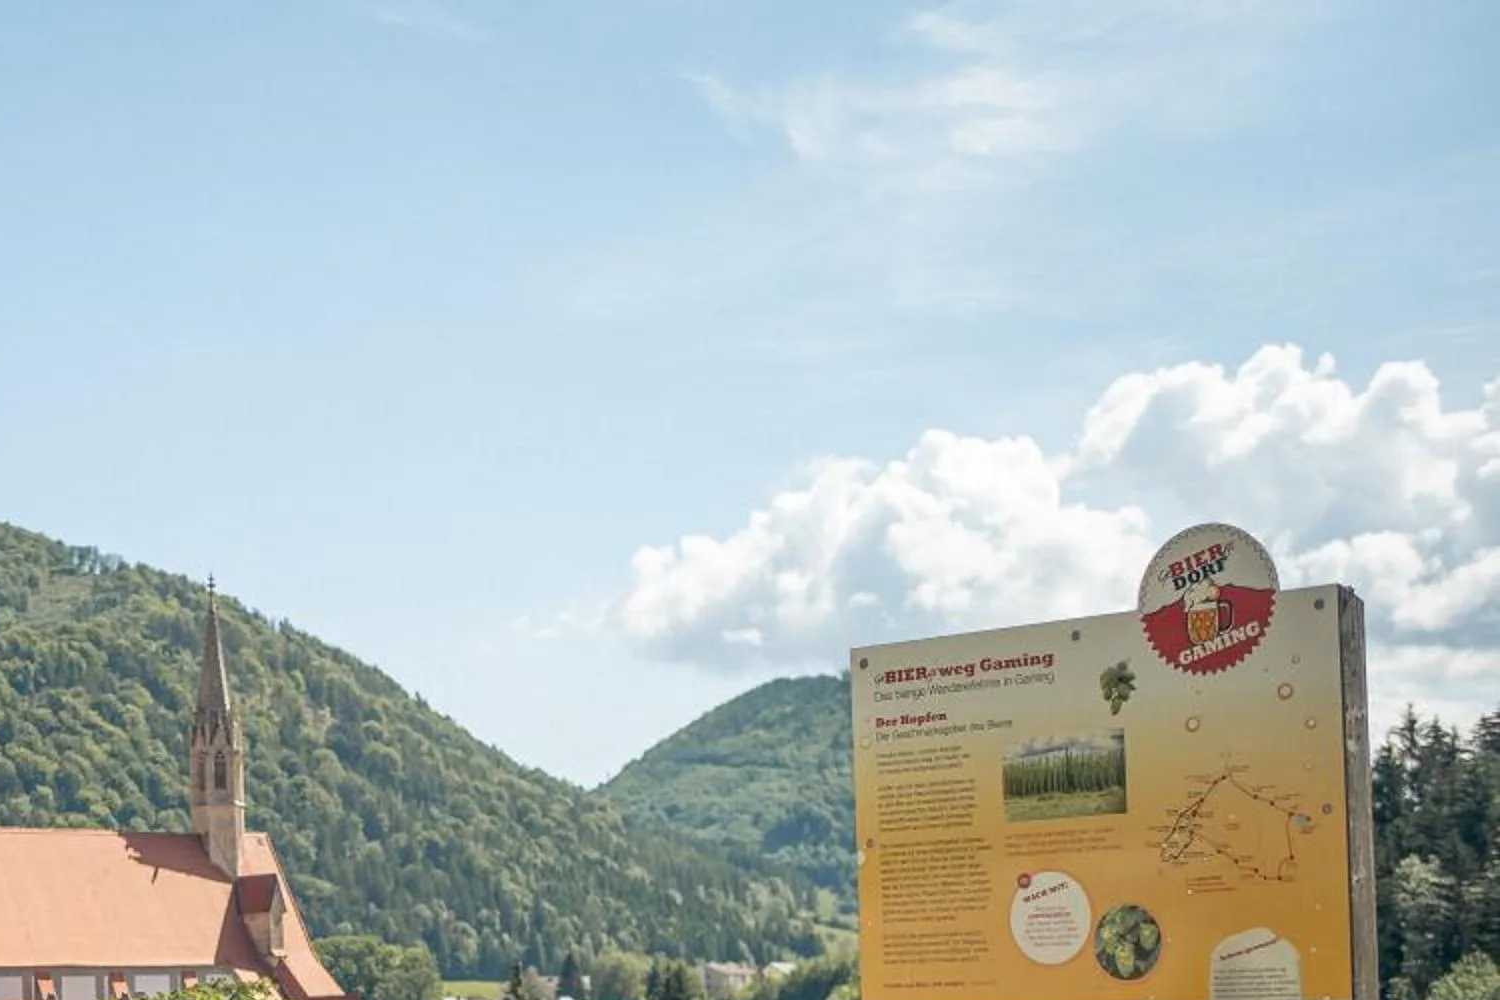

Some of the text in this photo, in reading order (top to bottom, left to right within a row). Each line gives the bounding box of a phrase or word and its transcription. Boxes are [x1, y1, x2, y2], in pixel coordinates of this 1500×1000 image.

[1171, 556, 1227, 591] DORF
[1179, 621, 1260, 665] GAMING
[979, 652, 1055, 672] Gaming
[876, 711, 947, 729] Der Hopfen
